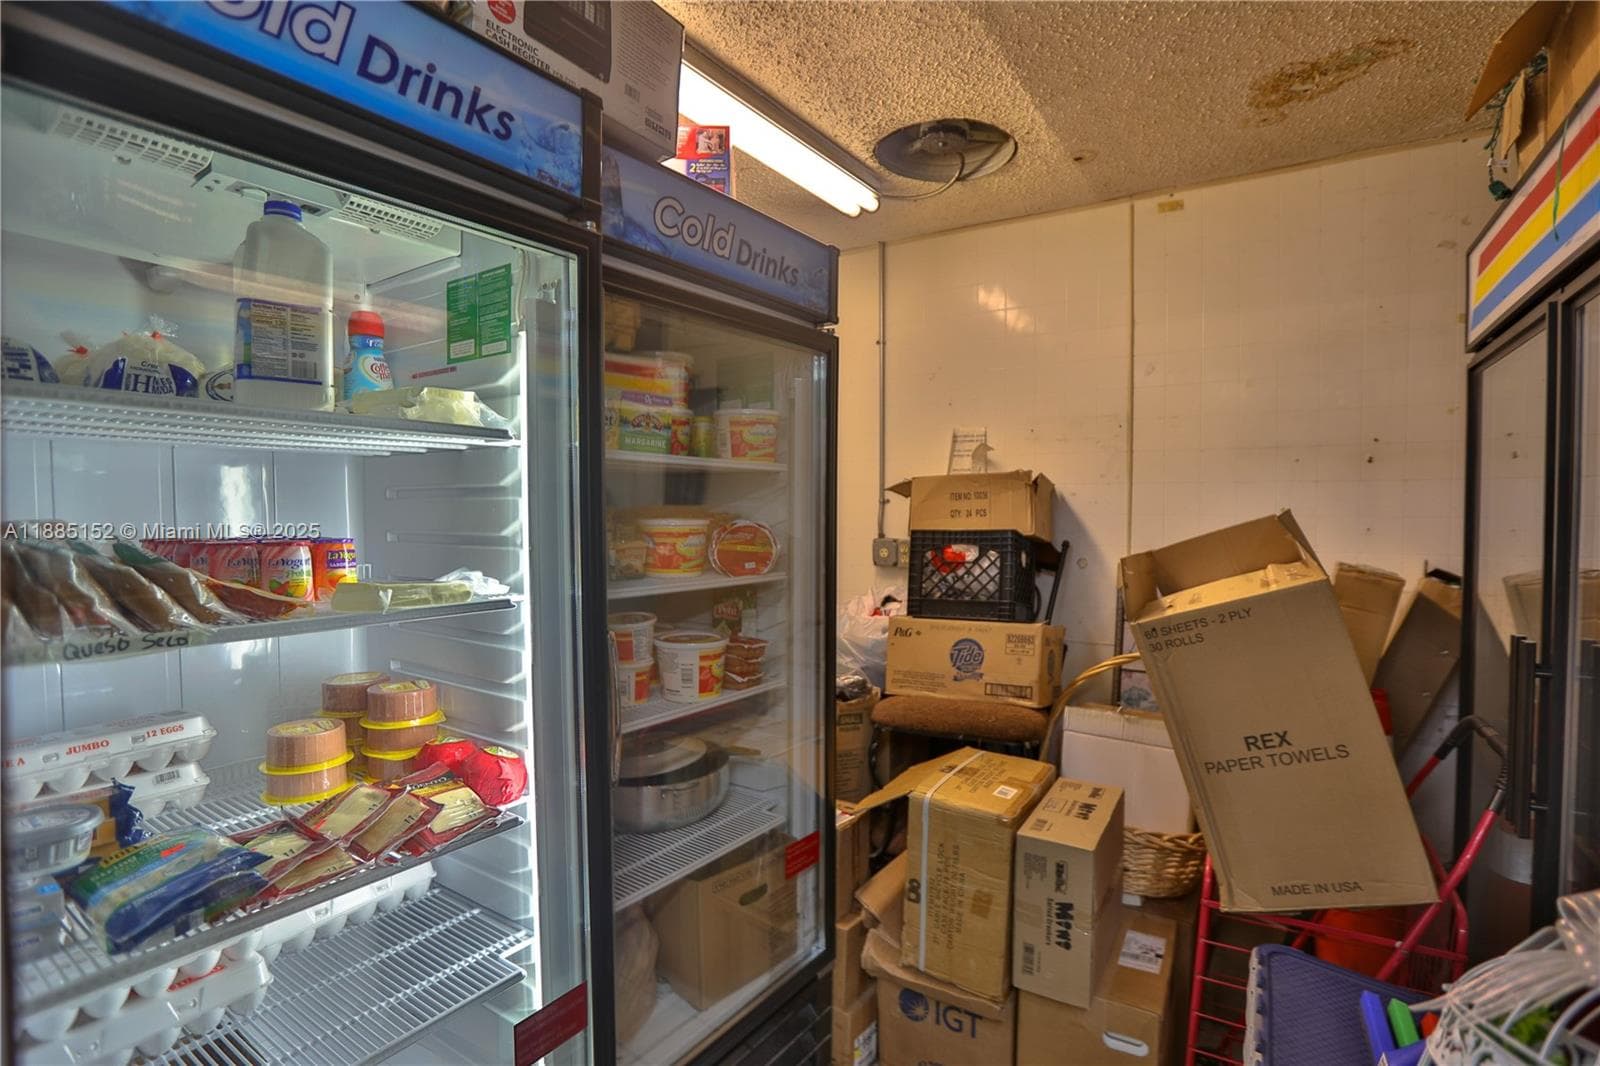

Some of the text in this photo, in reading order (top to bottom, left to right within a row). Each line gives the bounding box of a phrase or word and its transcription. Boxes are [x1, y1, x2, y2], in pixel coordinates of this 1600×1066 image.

[485, 19, 539, 56] ELECTRONIC
[485, 29, 551, 72] CASH REGISTER
[356, 34, 516, 142] Drinks
[653, 196, 799, 287] Cold Drinks
[975, 508, 987, 517] PCS
[893, 627, 913, 638] P&G
[1144, 627, 1158, 640] 60
[1160, 617, 1209, 636] SHEETS
[1218, 613, 1226, 624] 2
[1227, 607, 1252, 621] PLY
[1149, 633, 1205, 653] 30 ROLLS
[952, 645, 982, 666] Tide
[146, 723, 185, 739] 12 EGGS
[1243, 730, 1293, 752] REX
[65, 738, 111, 756] JUMBO
[1204, 744, 1351, 775] PAPER TOWELS
[1270, 881, 1364, 897] MADE IN USA
[936, 1000, 984, 1039] IGT
